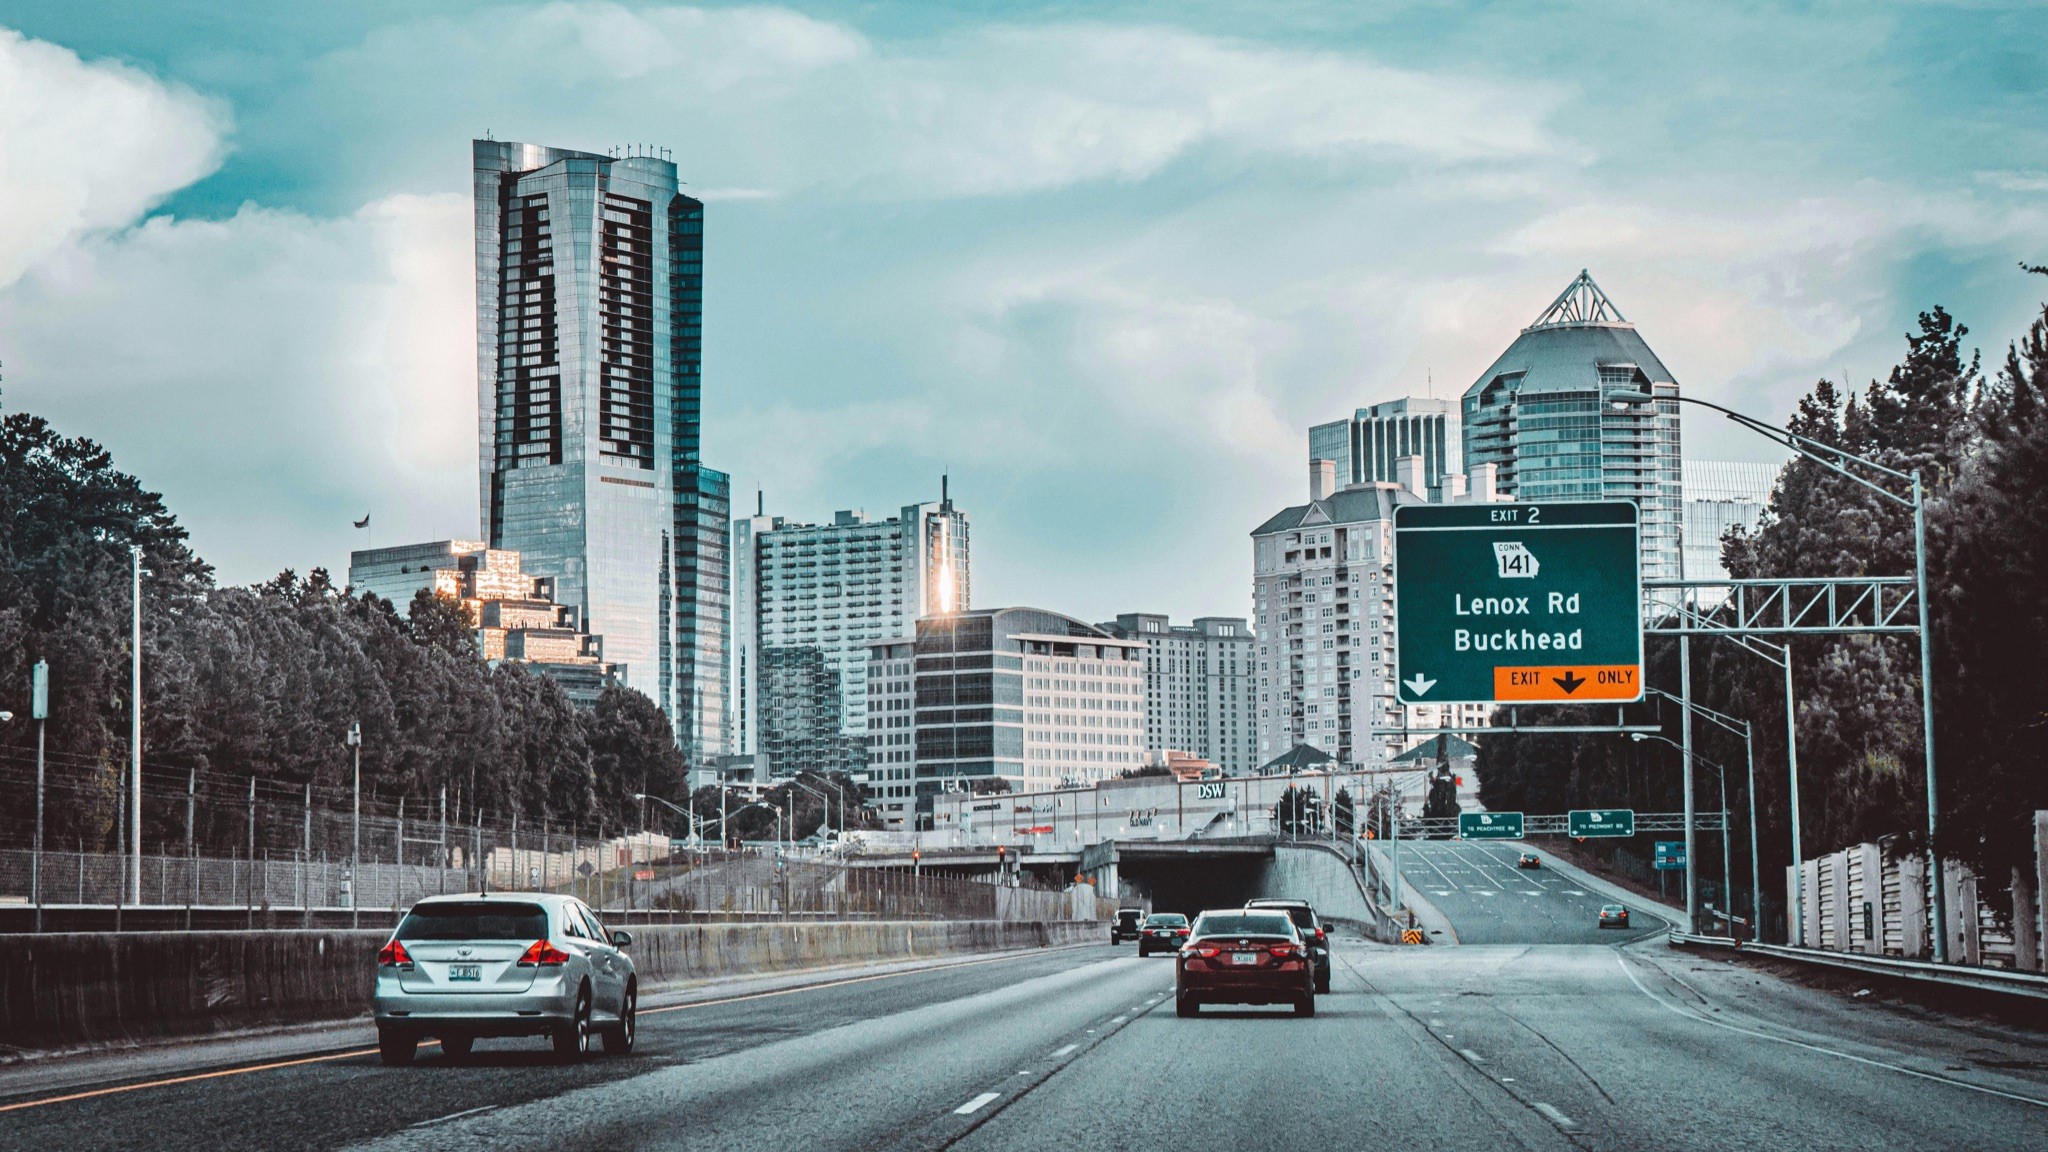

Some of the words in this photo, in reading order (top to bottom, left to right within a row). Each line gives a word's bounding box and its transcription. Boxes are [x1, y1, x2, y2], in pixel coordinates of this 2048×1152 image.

[1491, 509, 1518, 522] EXIT
[1528, 506, 1540, 524] 2
[1498, 544, 1520, 552] CONN
[1501, 554, 1530, 574] 141
[1455, 593, 1530, 615] Lenox
[1548, 592, 1580, 615] Rd
[1455, 628, 1582, 652] Buckhead
[1511, 671, 1541, 686] EXIT
[1598, 670, 1633, 684] ONLY
[1198, 783, 1224, 799] DSW
[1139, 817, 1152, 826] NAVY
